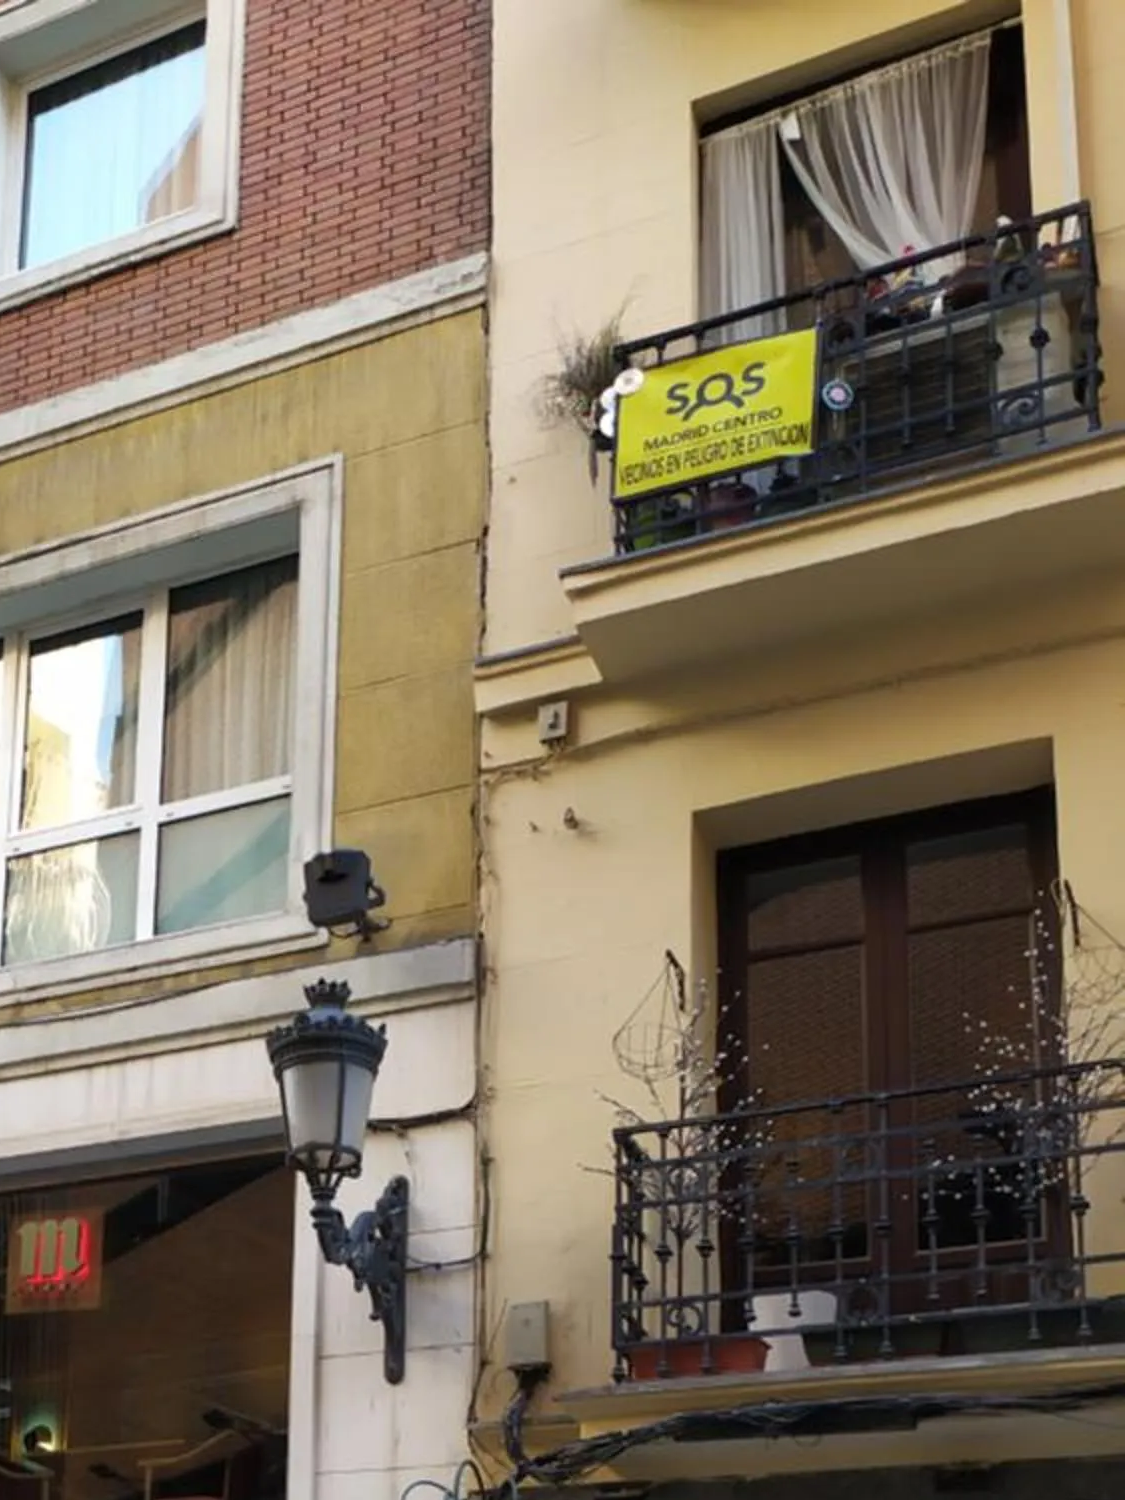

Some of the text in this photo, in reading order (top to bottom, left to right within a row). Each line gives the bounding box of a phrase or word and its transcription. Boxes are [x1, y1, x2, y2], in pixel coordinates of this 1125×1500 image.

[643, 407, 783, 452] MADRID CENTRO
[682, 438, 728, 469] PELIGRO
